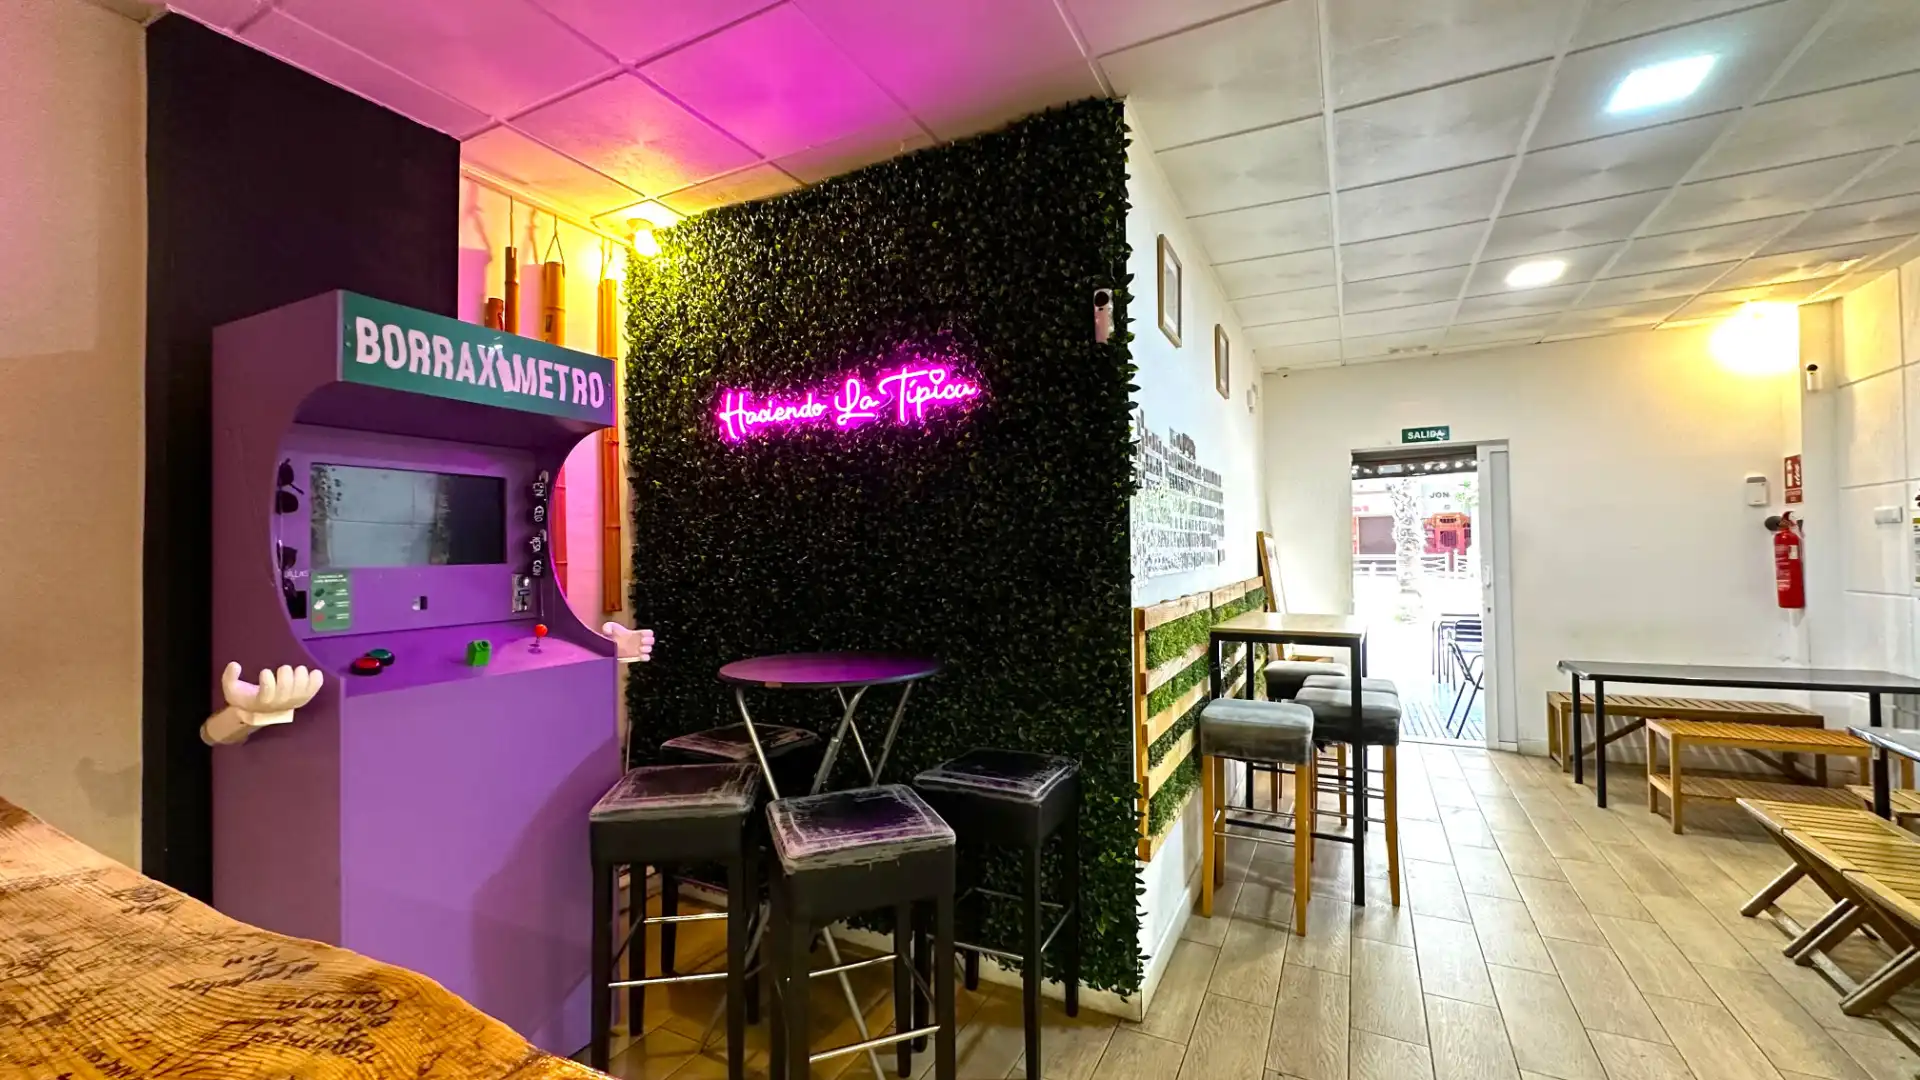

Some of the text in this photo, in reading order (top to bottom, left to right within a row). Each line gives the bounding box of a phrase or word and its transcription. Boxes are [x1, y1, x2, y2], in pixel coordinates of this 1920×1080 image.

[718, 392, 828, 440] Haciendo
[834, 378, 880, 426] La
[1407, 429, 1444, 440] SALIDA
